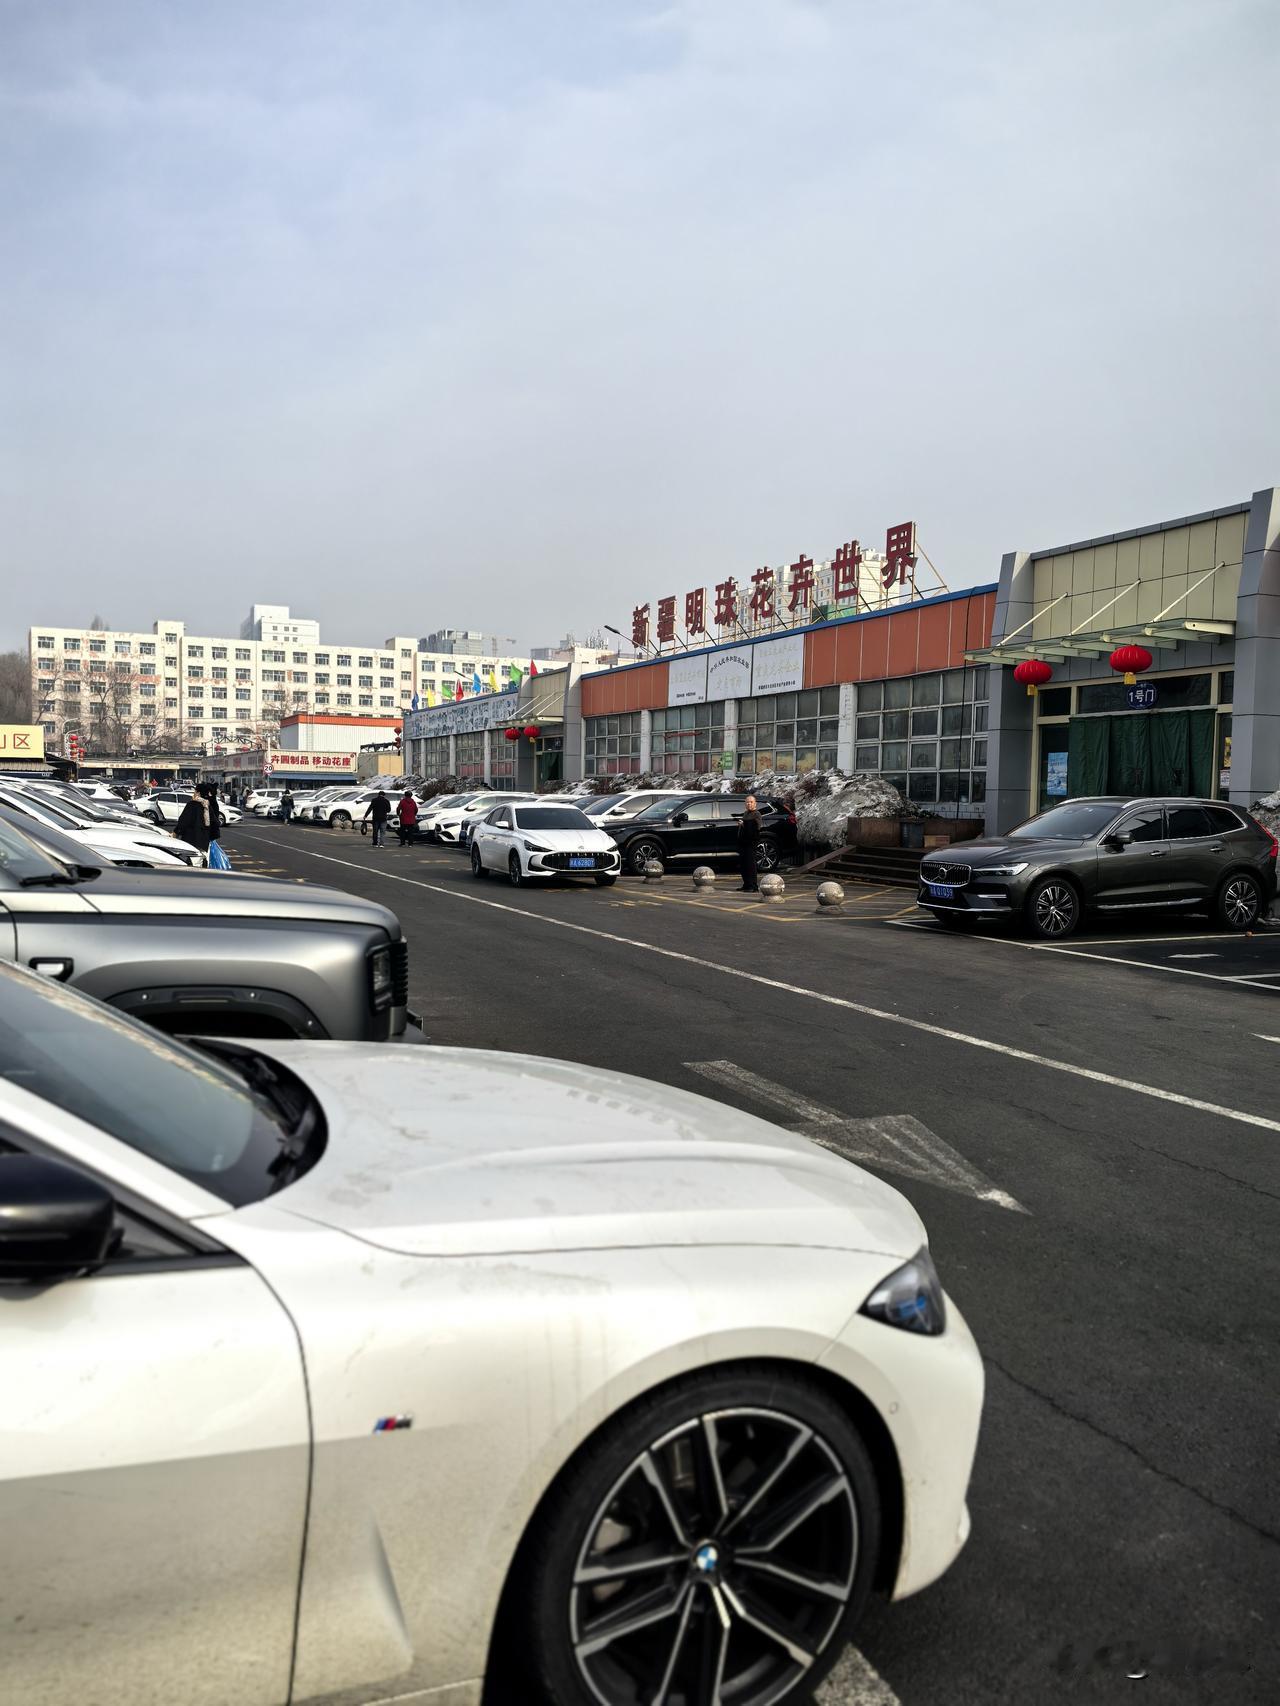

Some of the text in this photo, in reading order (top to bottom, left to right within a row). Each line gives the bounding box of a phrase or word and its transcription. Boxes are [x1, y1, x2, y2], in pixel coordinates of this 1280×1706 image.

[632, 521, 918, 649] 新疆明珠花卉世界
[1128, 689, 1154, 703] 1号门
[264, 764, 273, 772] 20
